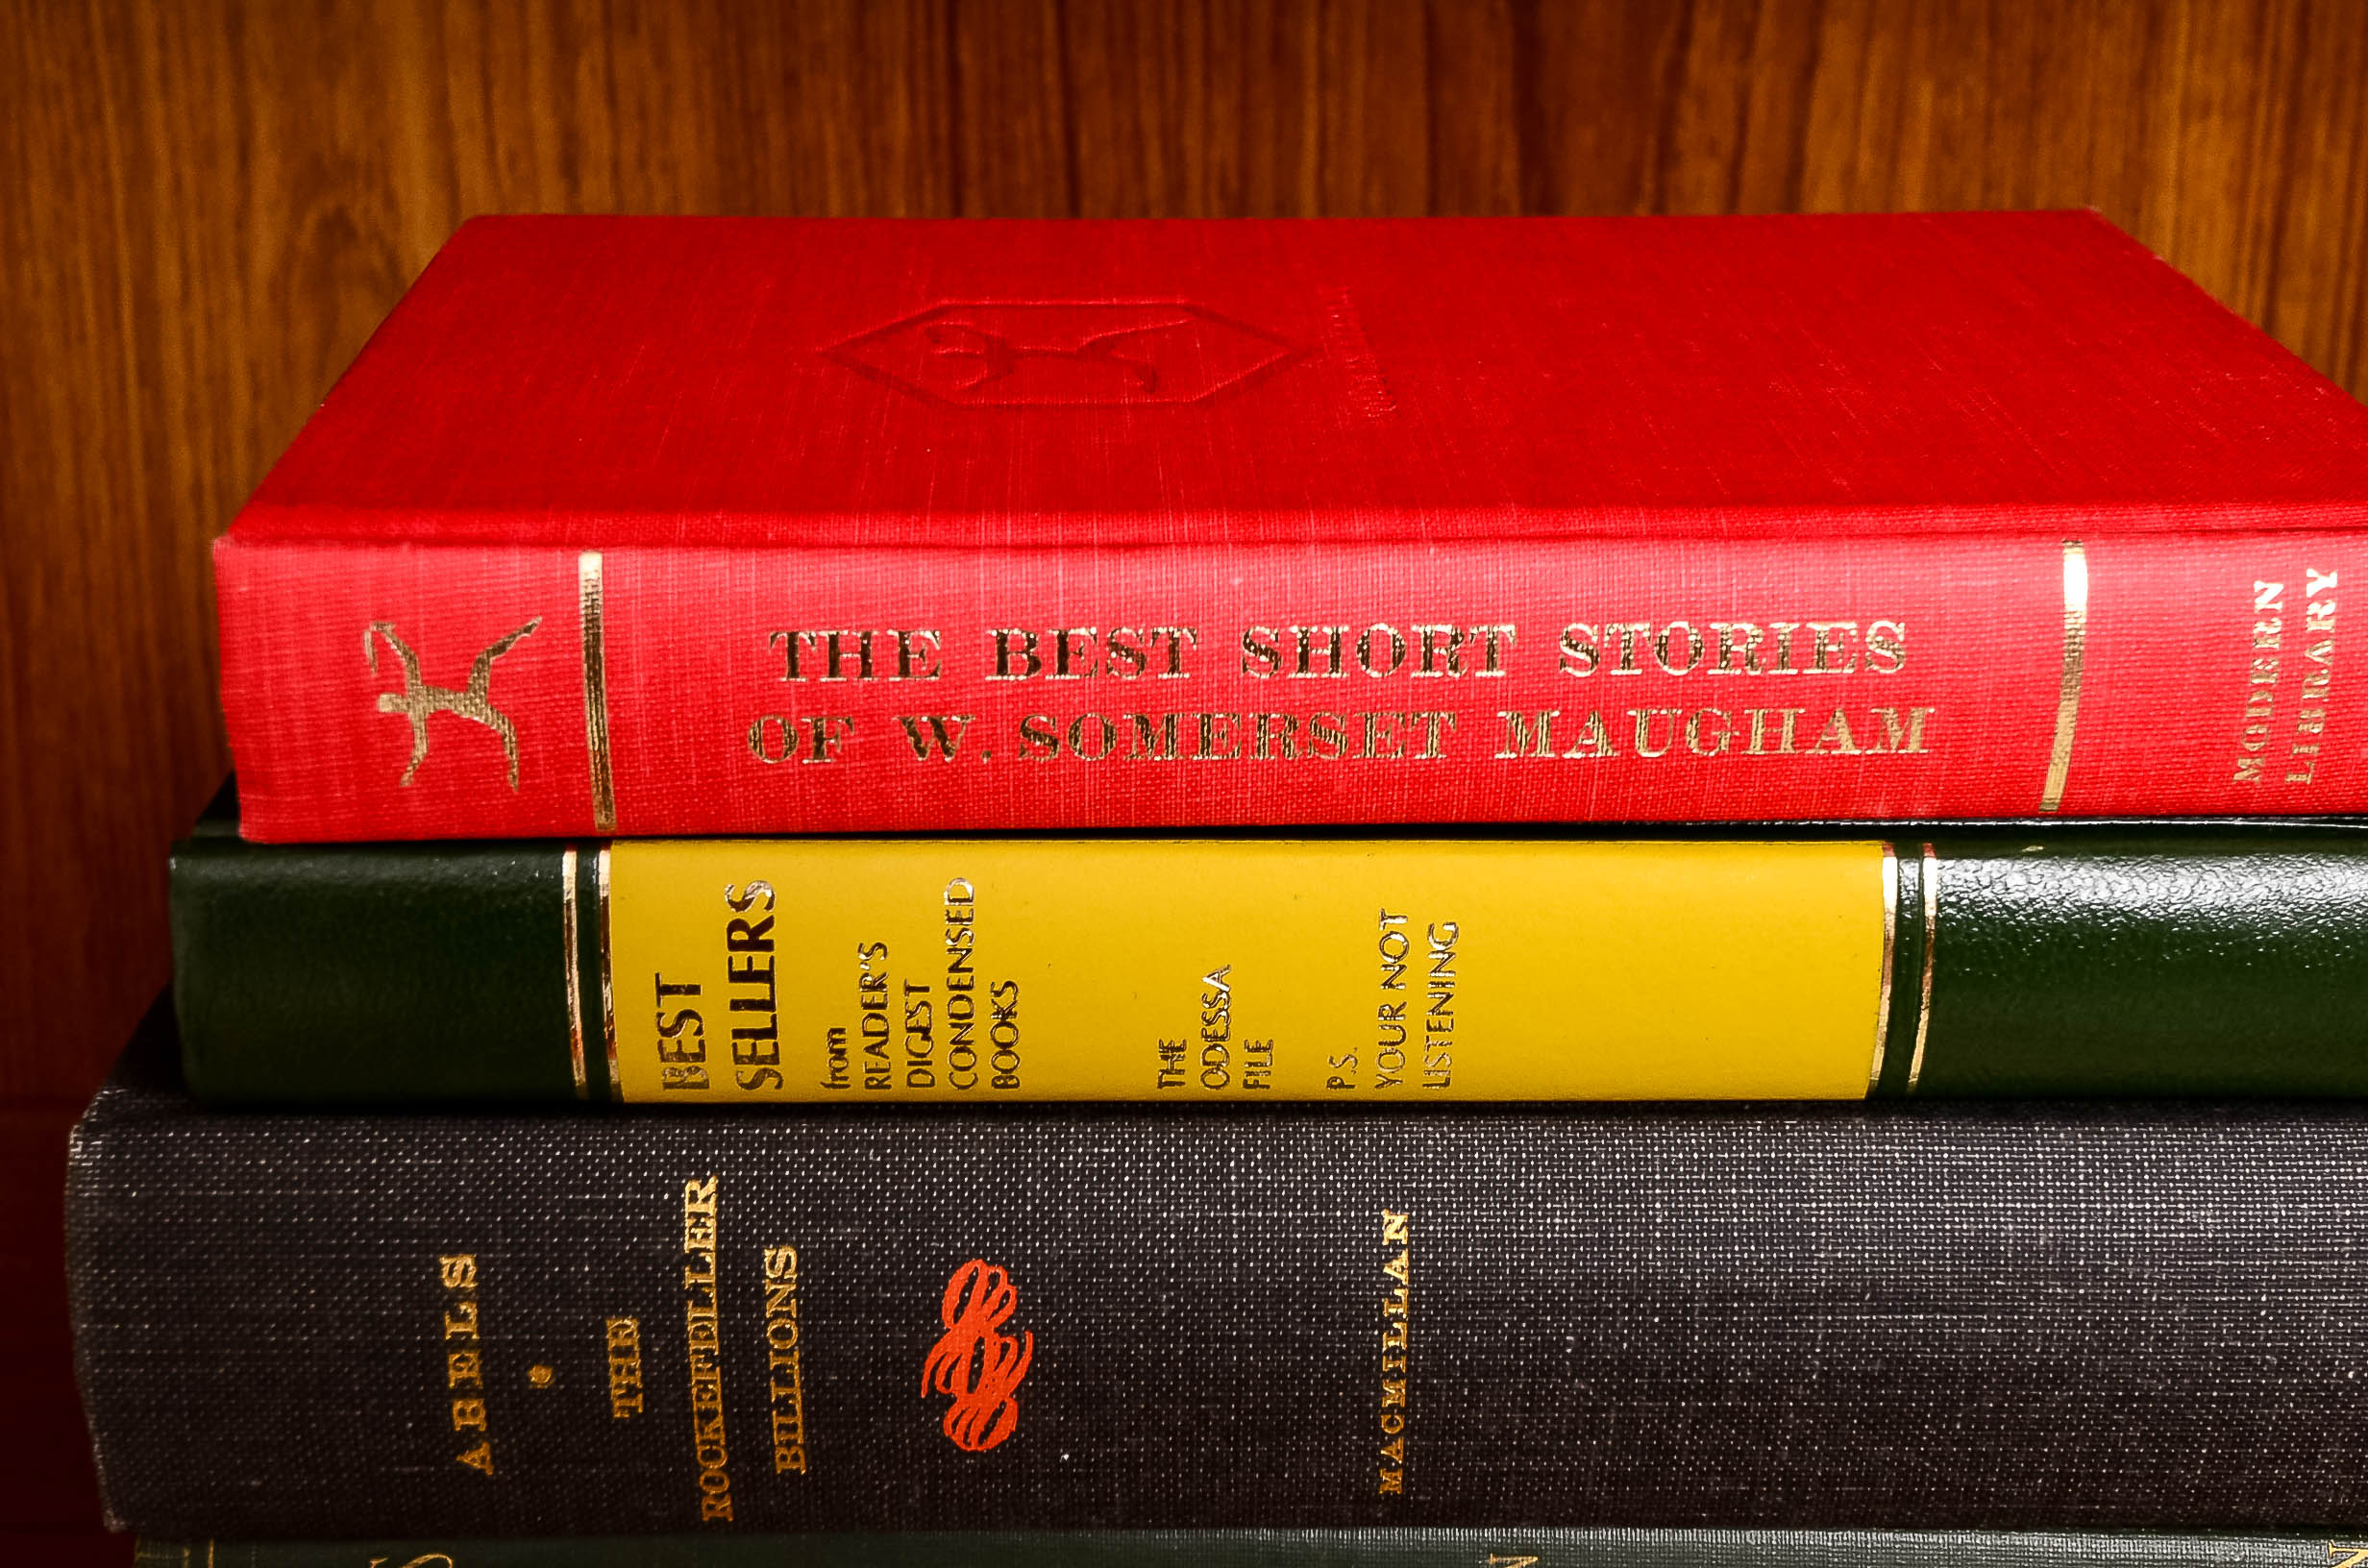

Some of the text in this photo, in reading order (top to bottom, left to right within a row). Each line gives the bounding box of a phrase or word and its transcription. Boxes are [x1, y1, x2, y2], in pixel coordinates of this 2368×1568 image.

[770, 620, 1908, 682] THE BEST SHORT STORIES
[2232, 579, 2284, 784] MODERN
[2284, 568, 2338, 785] LIBRARY
[747, 707, 1936, 765] OF W. SOMERSET MAUGHAM
[654, 971, 710, 1091] BEST
[724, 879, 785, 1091] SELLERS
[857, 941, 893, 1091] READER'S
[903, 977, 937, 1090] DIGEST
[942, 876, 979, 1091] CONDENSED
[989, 979, 1022, 1090] BOOKS
[1199, 964, 1232, 1090] ODESSA
[1374, 907, 1411, 1090] YOUR NOT
[1422, 920, 1460, 1090] LISTENING
[820, 1026, 851, 1090] from
[1157, 1038, 1188, 1090] THE
[1242, 1038, 1274, 1090] FILE
[1326, 1046, 1359, 1090] P.S.
[438, 1253, 495, 1477] ABELS
[604, 1315, 644, 1420] THE
[683, 1174, 734, 1523] ROCKEFELLER
[763, 1244, 807, 1476] BILLIONS
[1378, 1208, 1410, 1495] MACMILLAN
